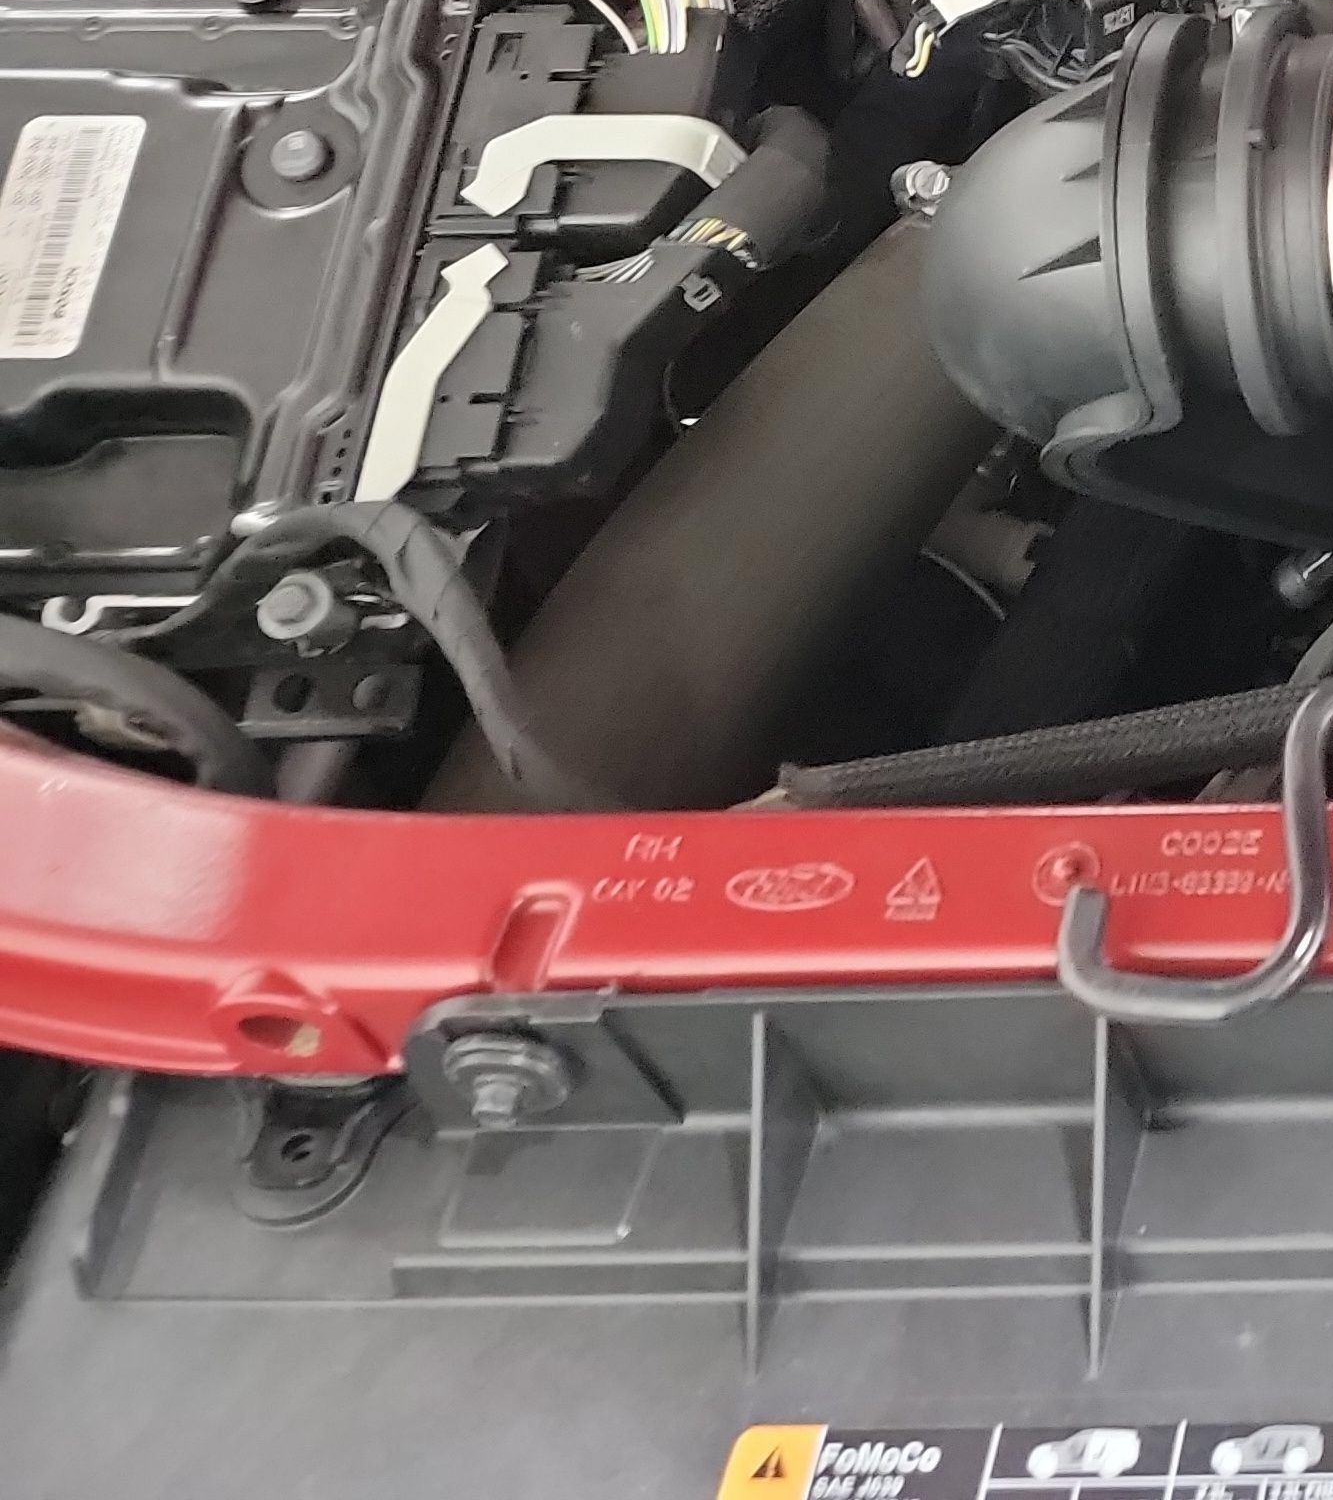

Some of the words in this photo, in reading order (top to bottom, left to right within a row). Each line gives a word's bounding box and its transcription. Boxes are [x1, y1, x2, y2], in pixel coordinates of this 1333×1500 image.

[623, 831, 684, 862] RH
[815, 1439, 943, 1477] FoMoCo
[810, 1474, 857, 1499] SAE
